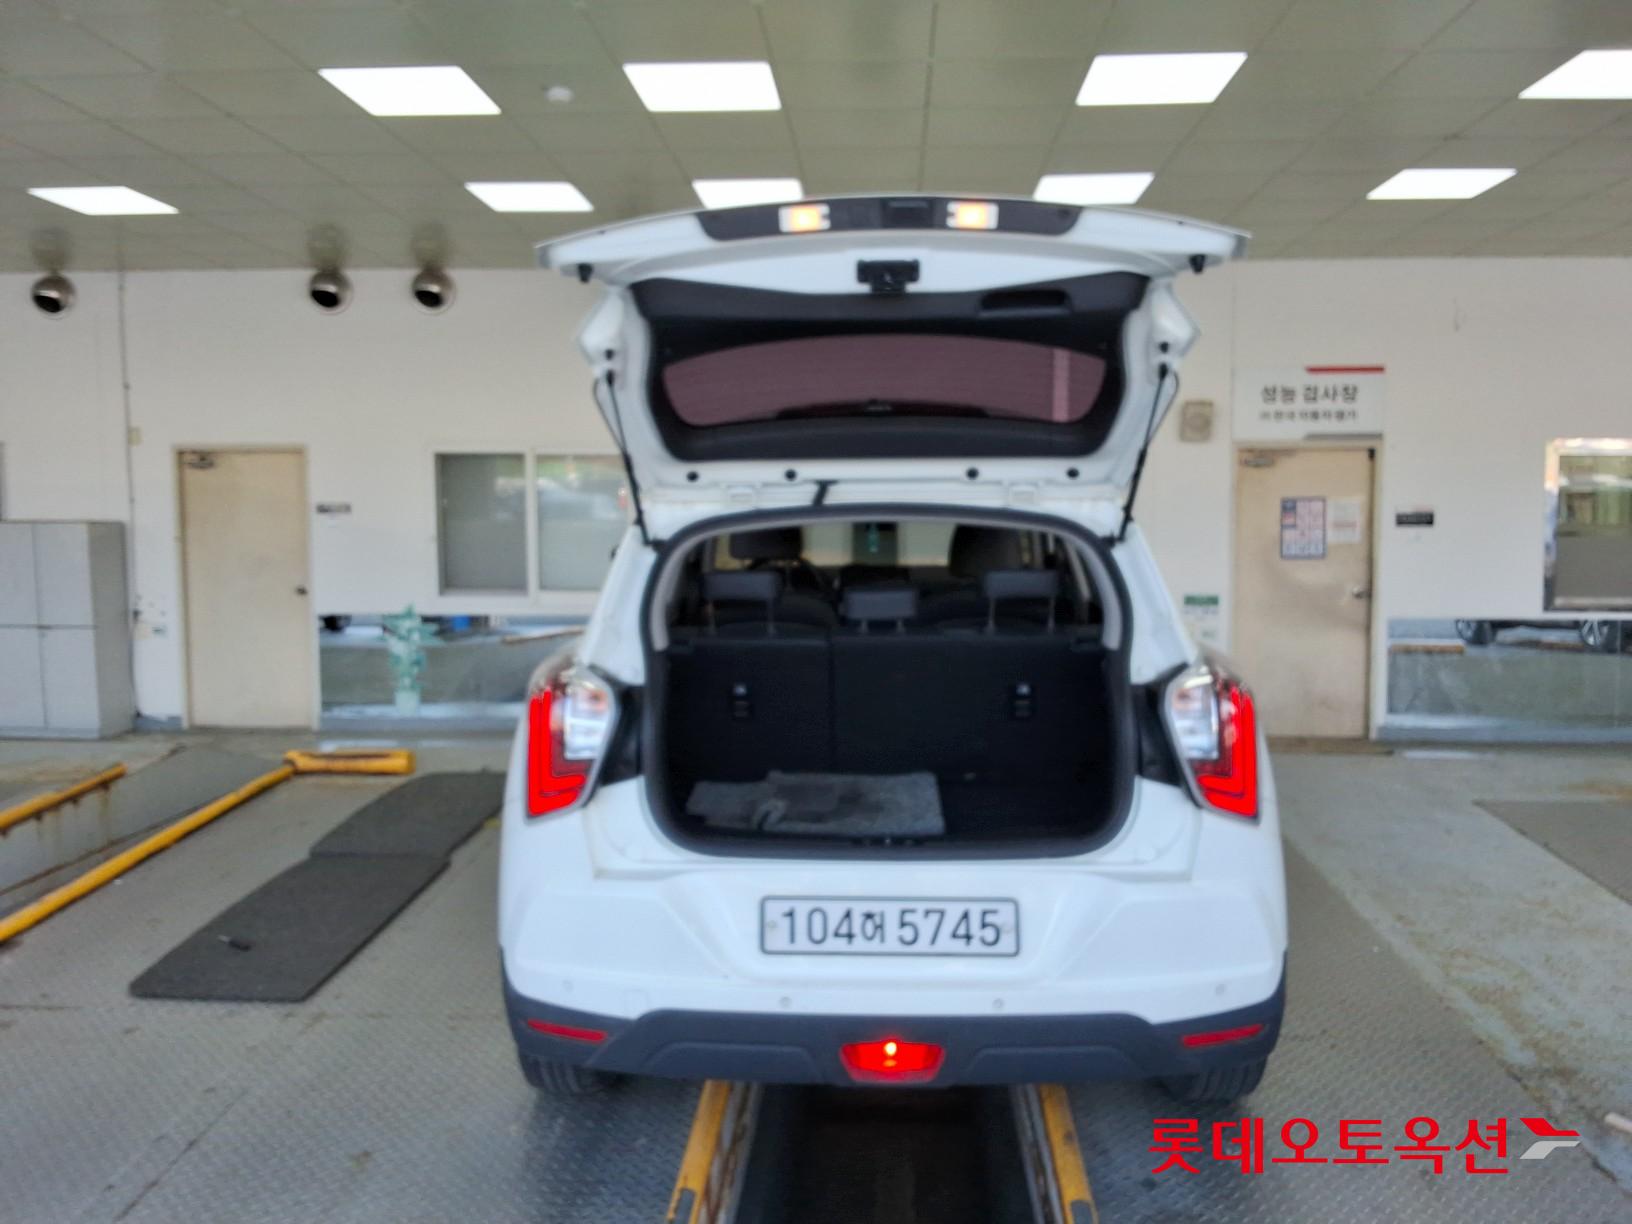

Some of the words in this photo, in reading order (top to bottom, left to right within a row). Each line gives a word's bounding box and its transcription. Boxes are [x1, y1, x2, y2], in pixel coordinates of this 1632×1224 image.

[1261, 383, 1296, 404] 성능
[1303, 383, 1359, 404] 검사장
[781, 906, 886, 946] 104허
[898, 909, 1002, 947] 5745
